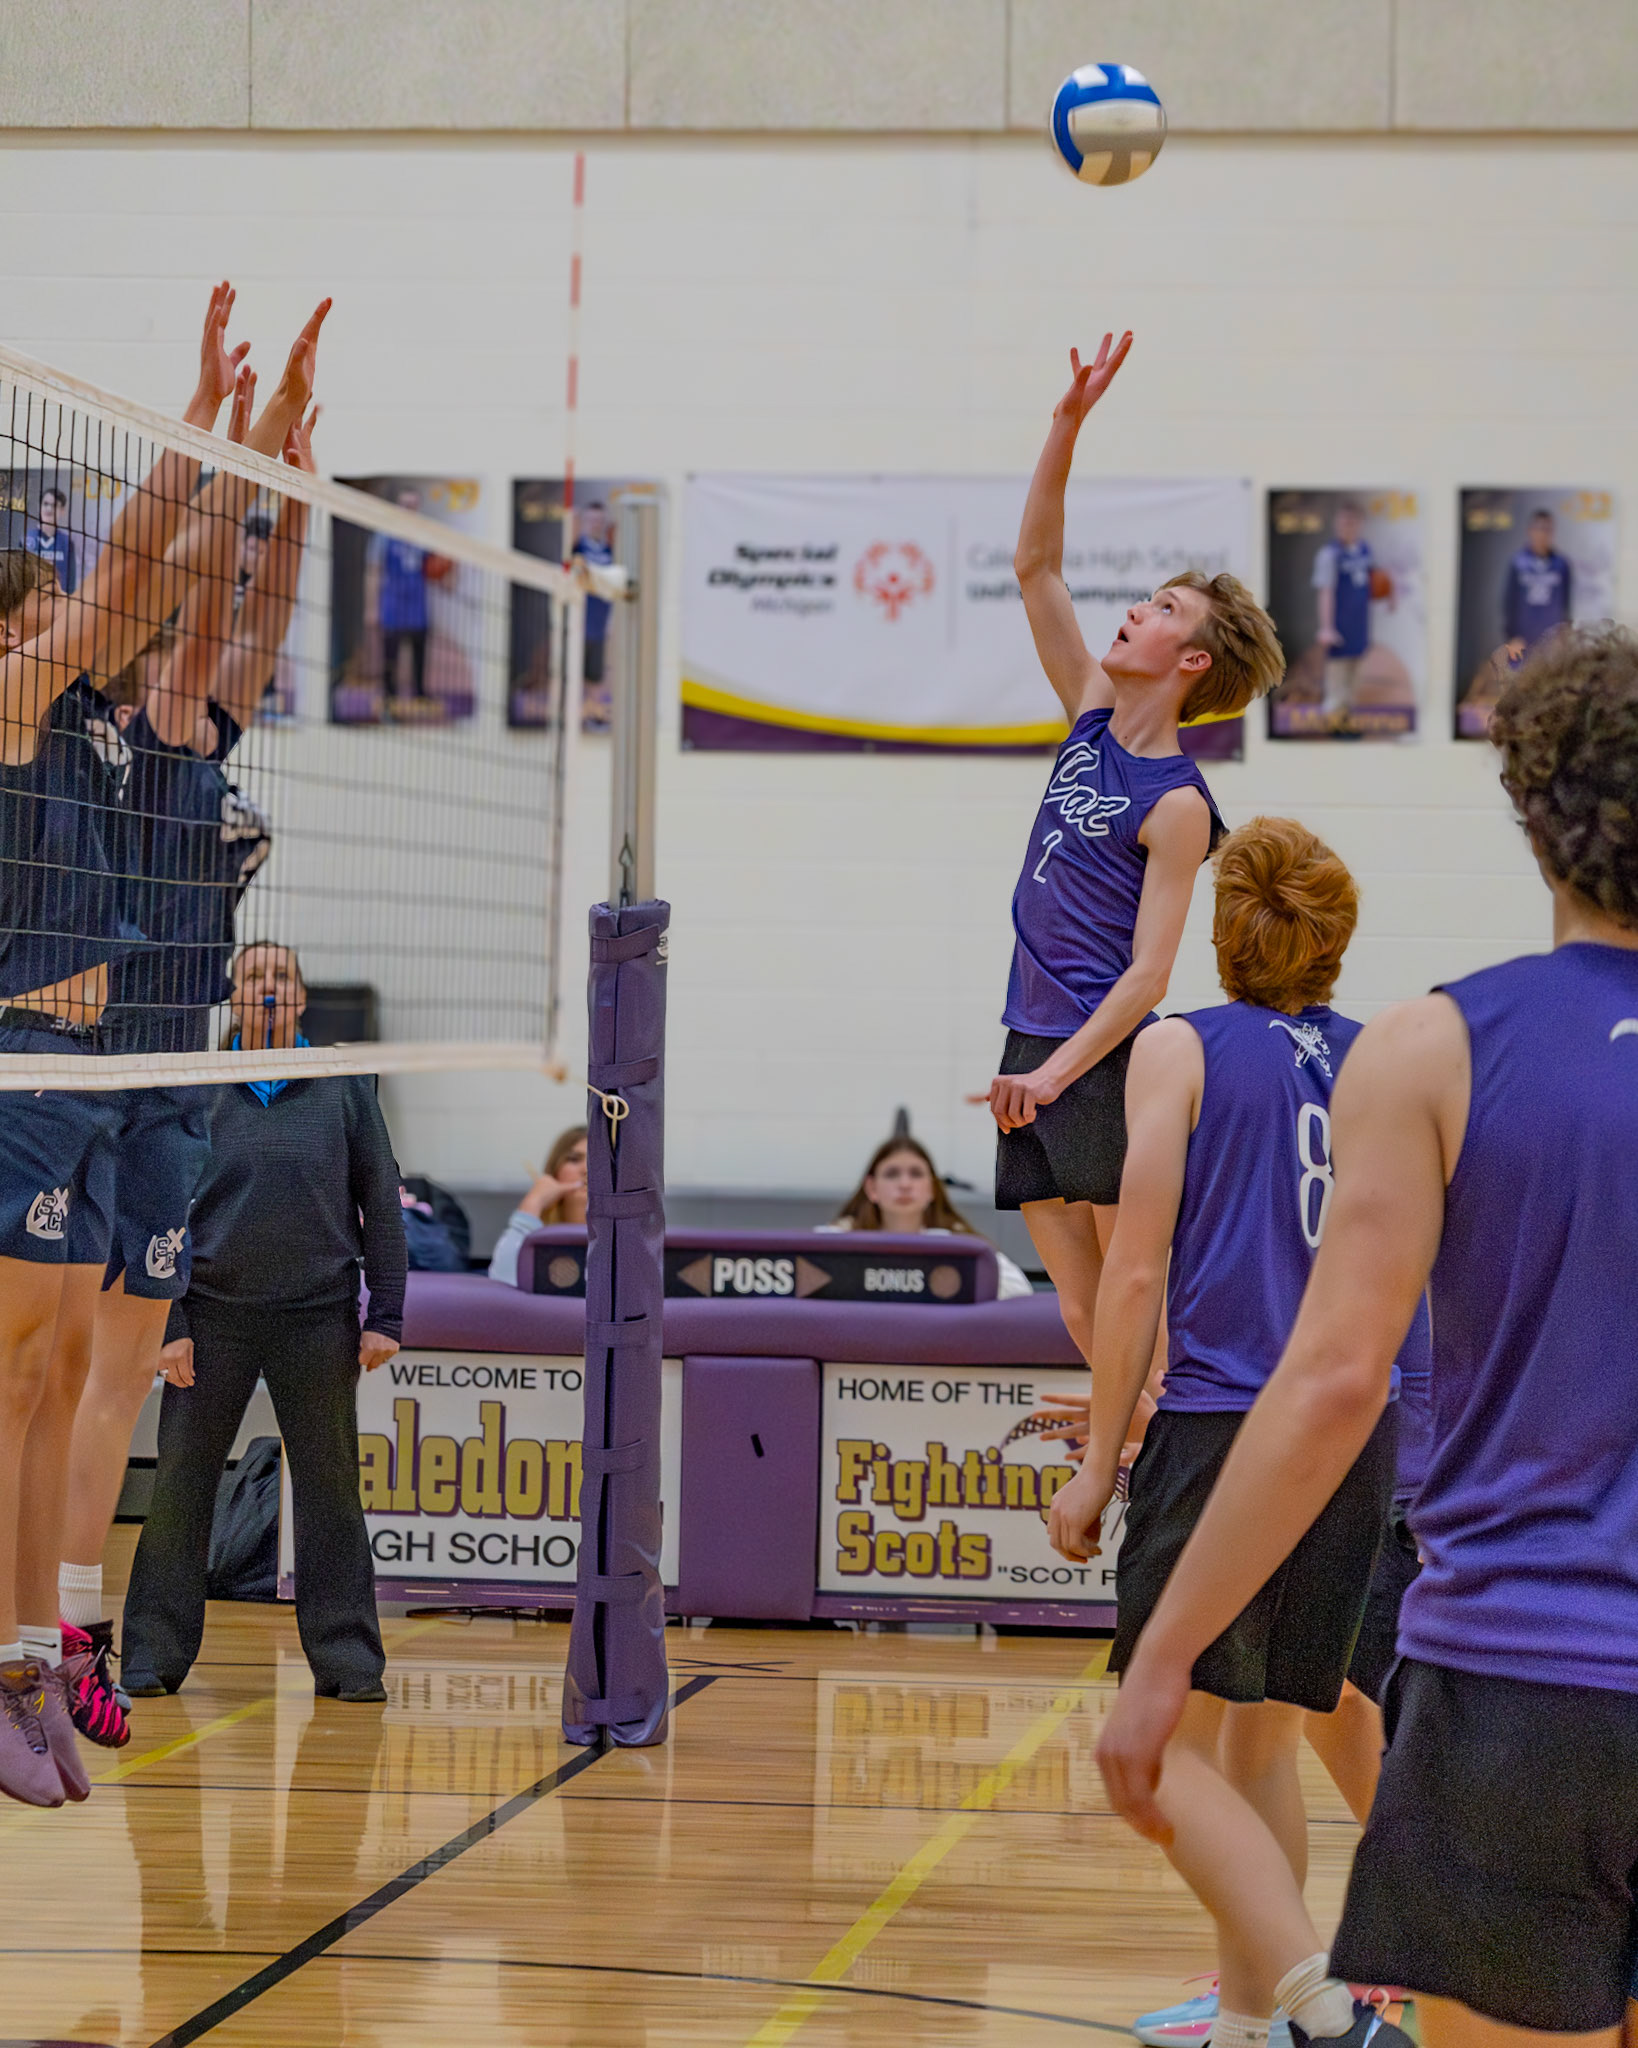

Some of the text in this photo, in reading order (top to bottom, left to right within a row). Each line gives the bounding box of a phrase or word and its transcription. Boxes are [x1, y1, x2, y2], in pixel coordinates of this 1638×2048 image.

[1032, 829, 1063, 884] 2
[1299, 1101, 1336, 1249] 8
[713, 1257, 925, 1295] POSS BONUS
[390, 1364, 583, 1391] WELCOME TO
[838, 1378, 1034, 1406] HOME OF THE
[357, 1397, 583, 1523] aledon
[371, 1528, 579, 1568] GH SCHO
[835, 1510, 992, 1580] Scots
[998, 1566, 1118, 1587] "SCOT P
